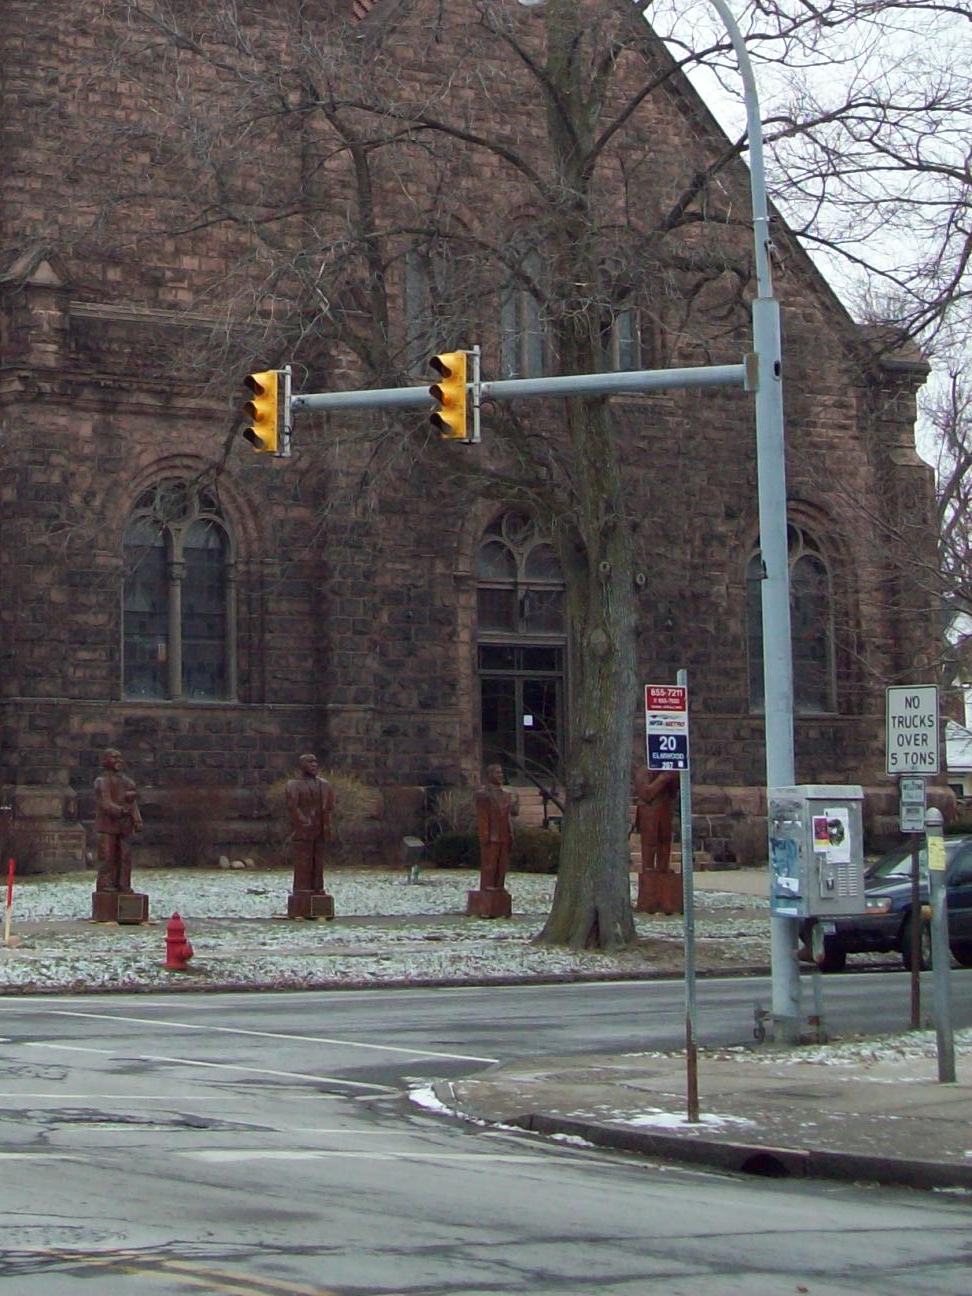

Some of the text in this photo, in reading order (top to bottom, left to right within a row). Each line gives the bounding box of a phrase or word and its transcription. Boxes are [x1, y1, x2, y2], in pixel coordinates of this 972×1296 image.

[904, 695, 920, 709] NO
[891, 714, 934, 729] TRUCKS
[659, 736, 676, 751] 20
[897, 733, 928, 747] OVER
[890, 751, 935, 766] 5 TONS
